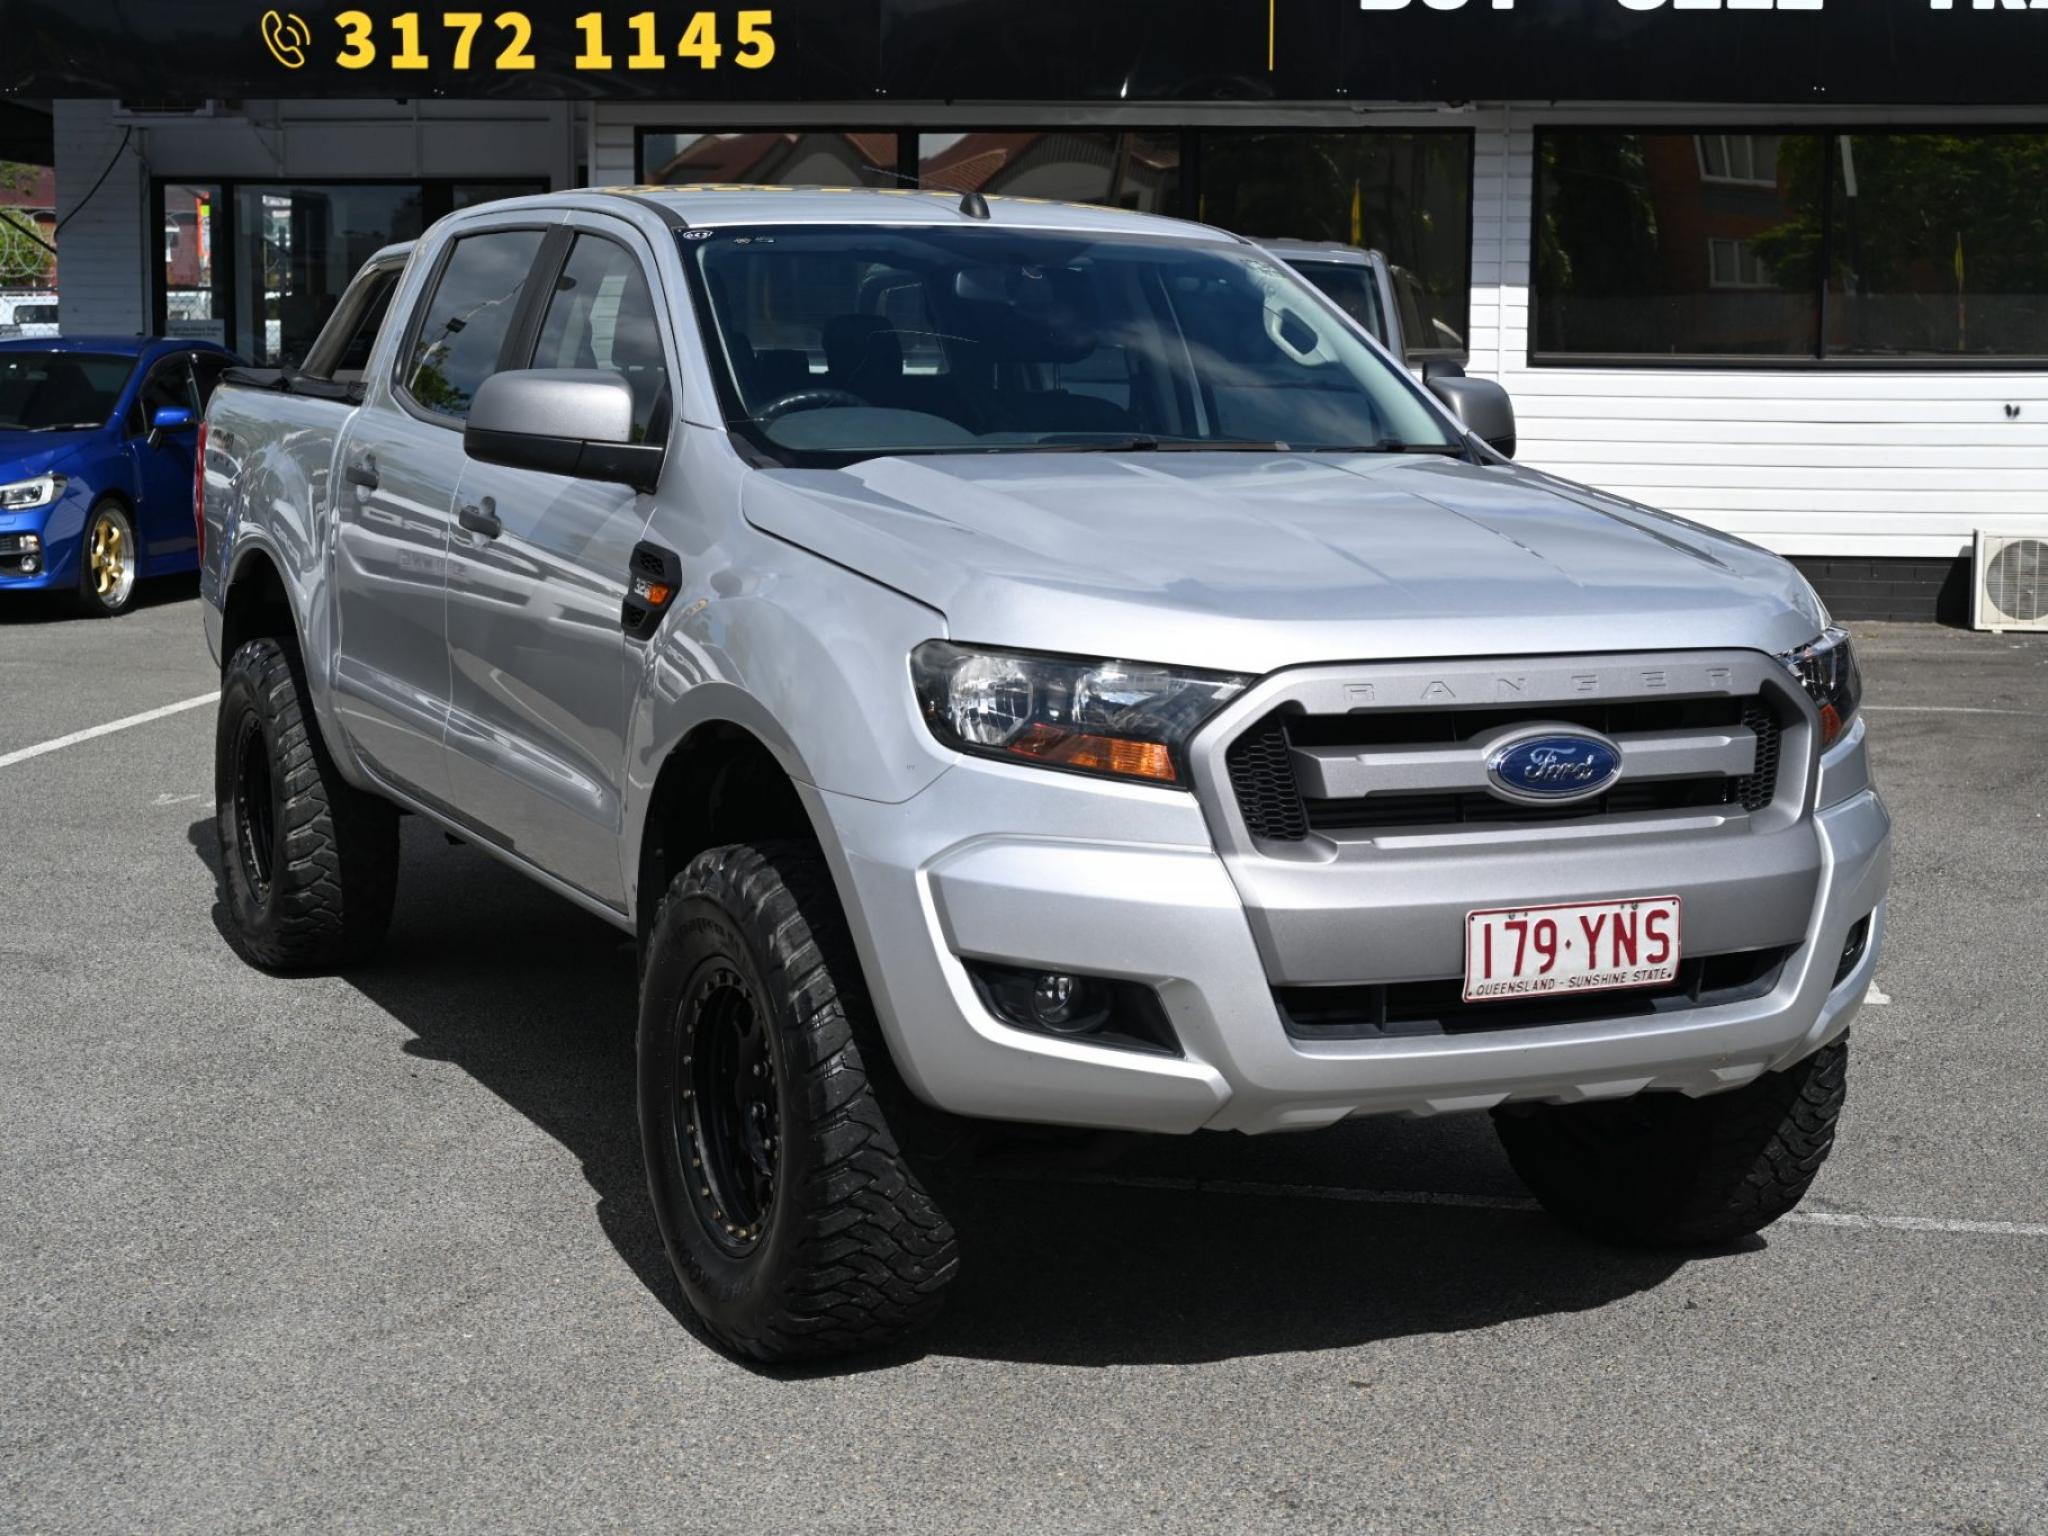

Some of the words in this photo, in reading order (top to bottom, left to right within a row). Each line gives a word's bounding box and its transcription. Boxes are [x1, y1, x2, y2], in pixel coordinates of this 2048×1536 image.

[335, 10, 535, 70] 3172
[575, 10, 776, 69] 1145
[1343, 668, 1732, 701] RANGER
[1524, 747, 1595, 781] Ford
[1476, 978, 1556, 996] QUEENSLAND
[1568, 972, 1628, 988] SUNSHINE
[1633, 968, 1668, 981] STATE
